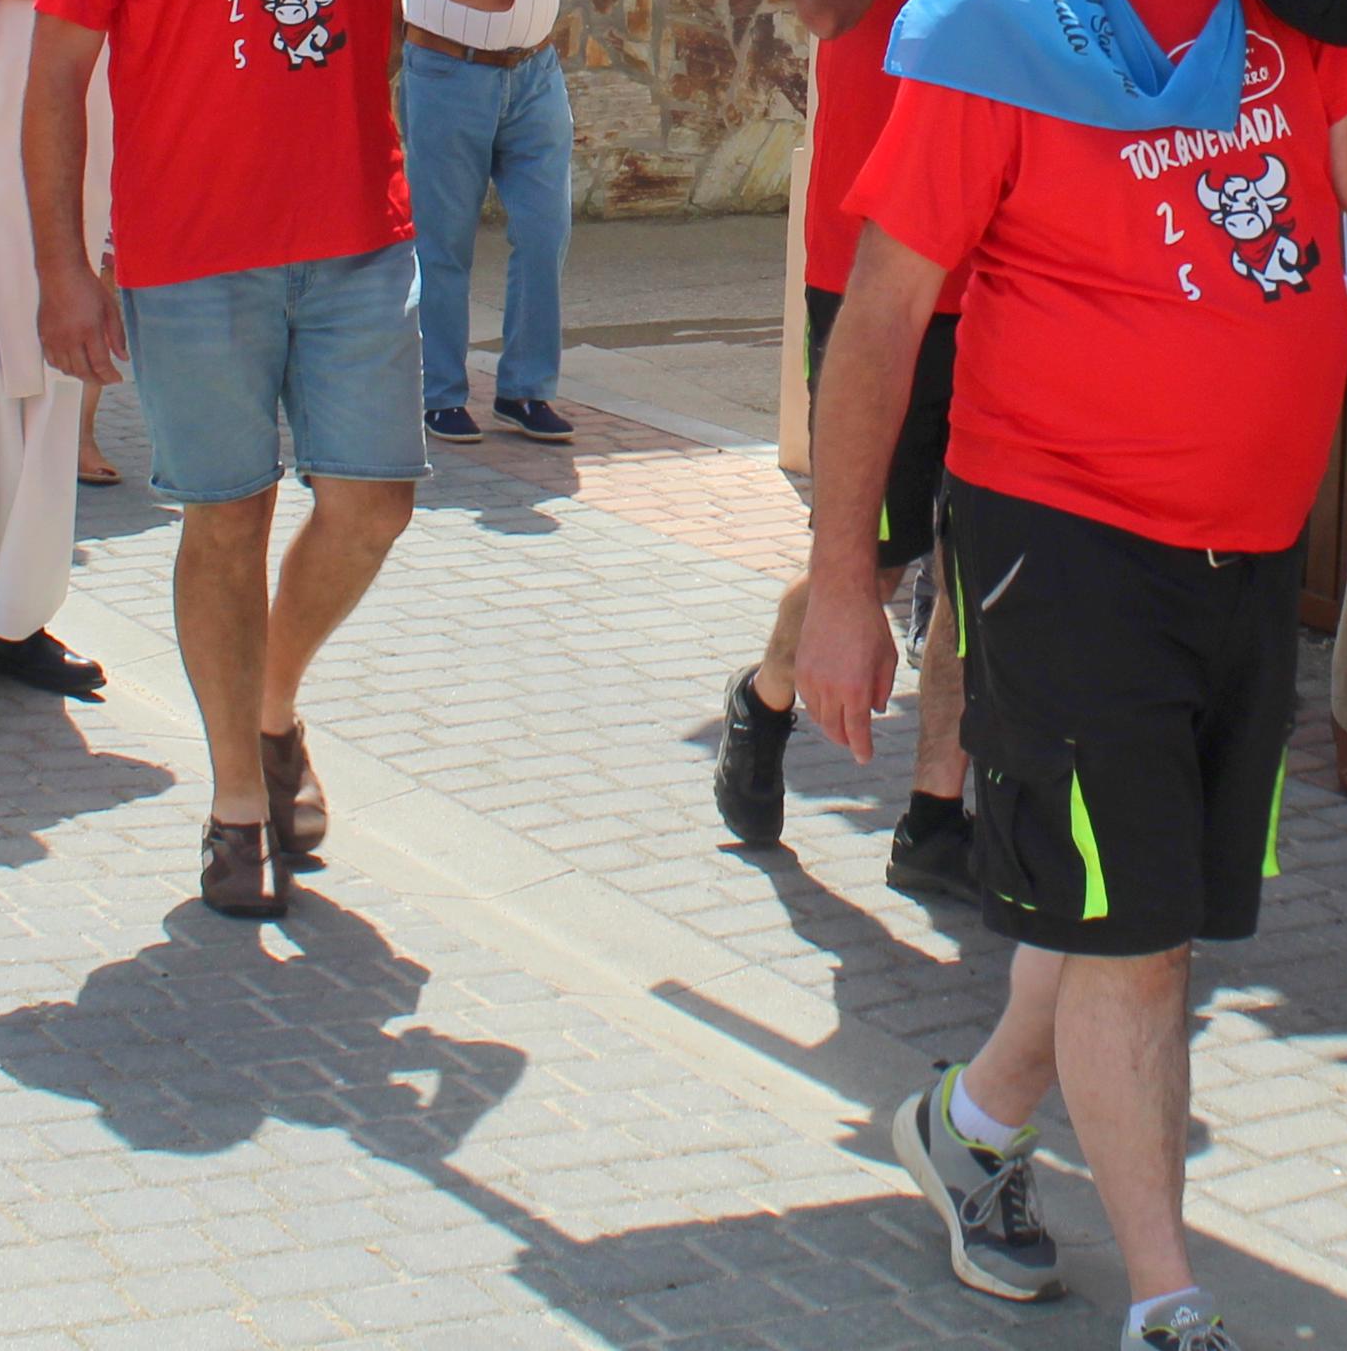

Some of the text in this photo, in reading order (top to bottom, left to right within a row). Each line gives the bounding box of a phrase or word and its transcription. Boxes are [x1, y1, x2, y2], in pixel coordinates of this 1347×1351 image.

[233, 38, 247, 69] 5
[1120, 103, 1292, 180] TORQUEMADA
[1156, 201, 1185, 245] 2
[1178, 262, 1201, 302] 5
